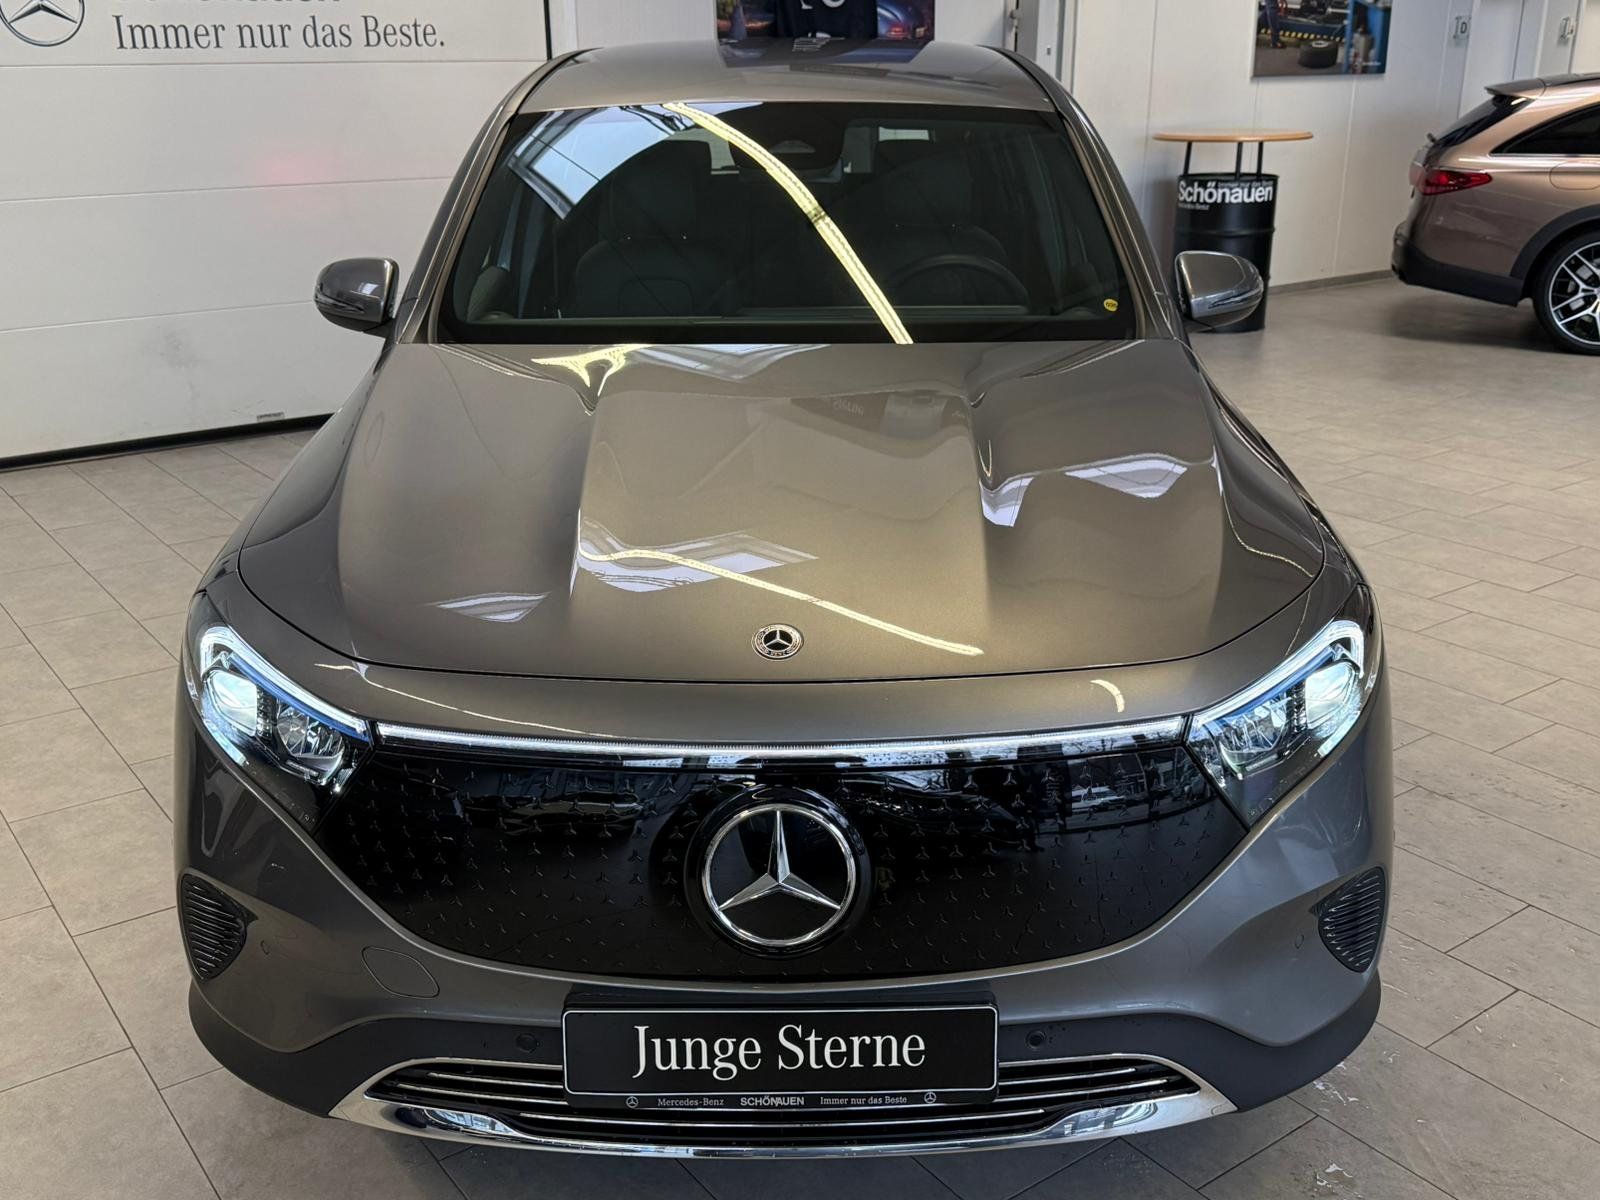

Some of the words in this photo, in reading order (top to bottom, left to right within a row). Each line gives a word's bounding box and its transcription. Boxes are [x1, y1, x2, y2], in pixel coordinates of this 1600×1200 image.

[113, 14, 225, 50] Immer
[236, 22, 291, 49] nur
[302, 16, 352, 48] das
[361, 15, 445, 48] Beste.
[1179, 180, 1273, 204] Schönauen
[632, 1025, 762, 1081] Junge
[778, 1024, 926, 1071] Sterne
[657, 1097, 725, 1107] Mercedes-Benz
[740, 1095, 805, 1106] SCHÖNAUEN
[820, 1096, 848, 1105] Immer
[850, 1096, 866, 1105] nur
[868, 1096, 883, 1105] das
[885, 1095, 908, 1104] Beste
